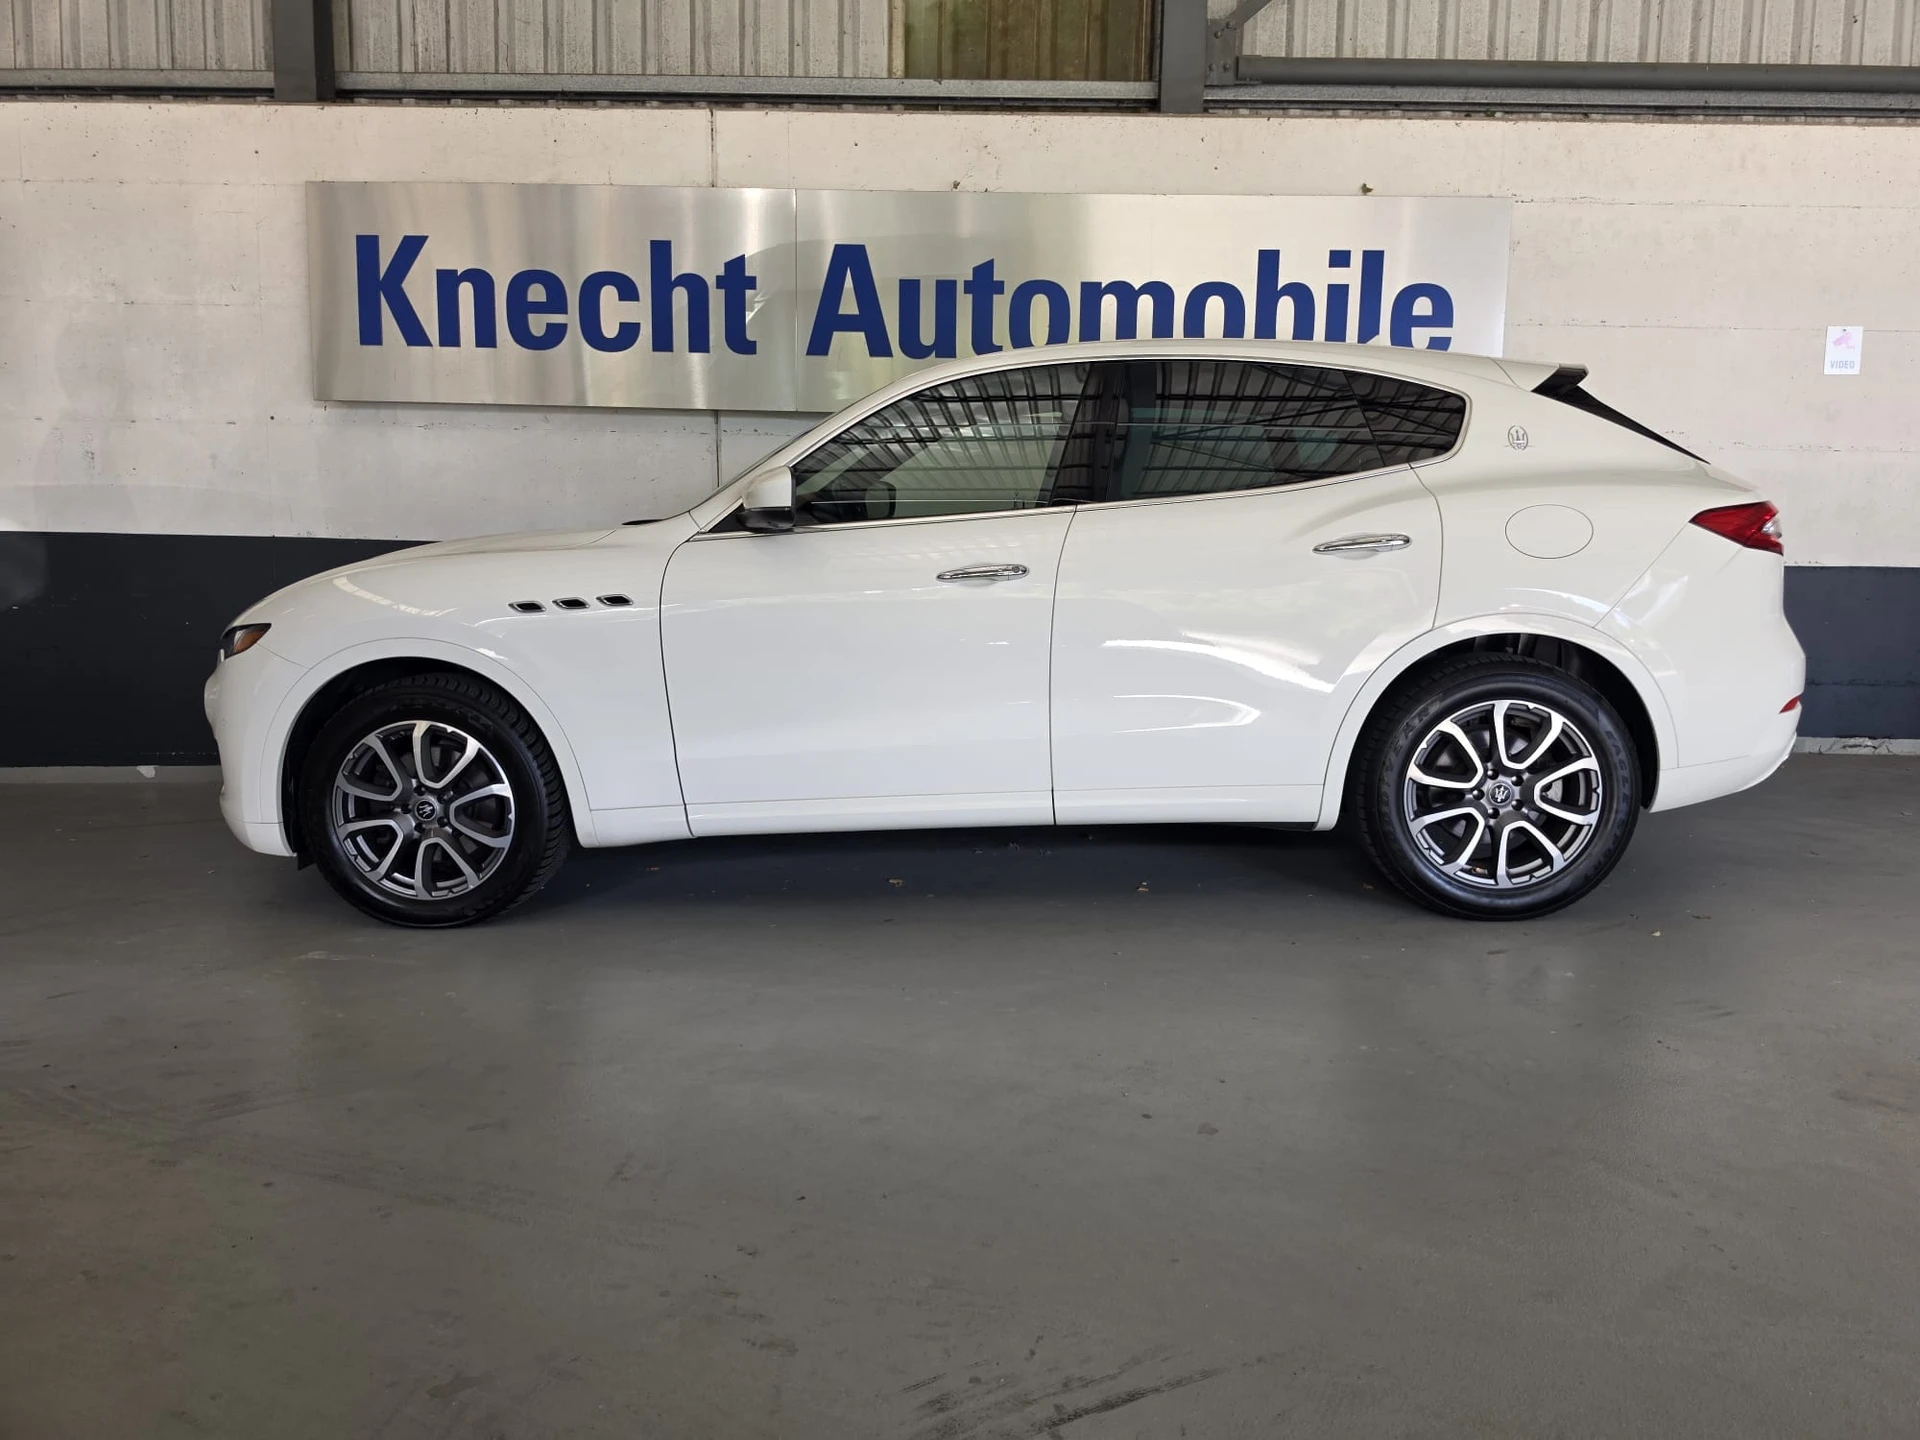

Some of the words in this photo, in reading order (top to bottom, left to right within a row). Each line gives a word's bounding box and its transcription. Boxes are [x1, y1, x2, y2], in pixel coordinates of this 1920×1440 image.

[356, 234, 757, 356] Knecht
[807, 243, 1454, 359] Automobile
[1830, 360, 1855, 369] VIDEO
[1605, 730, 1629, 808] EAGLE
